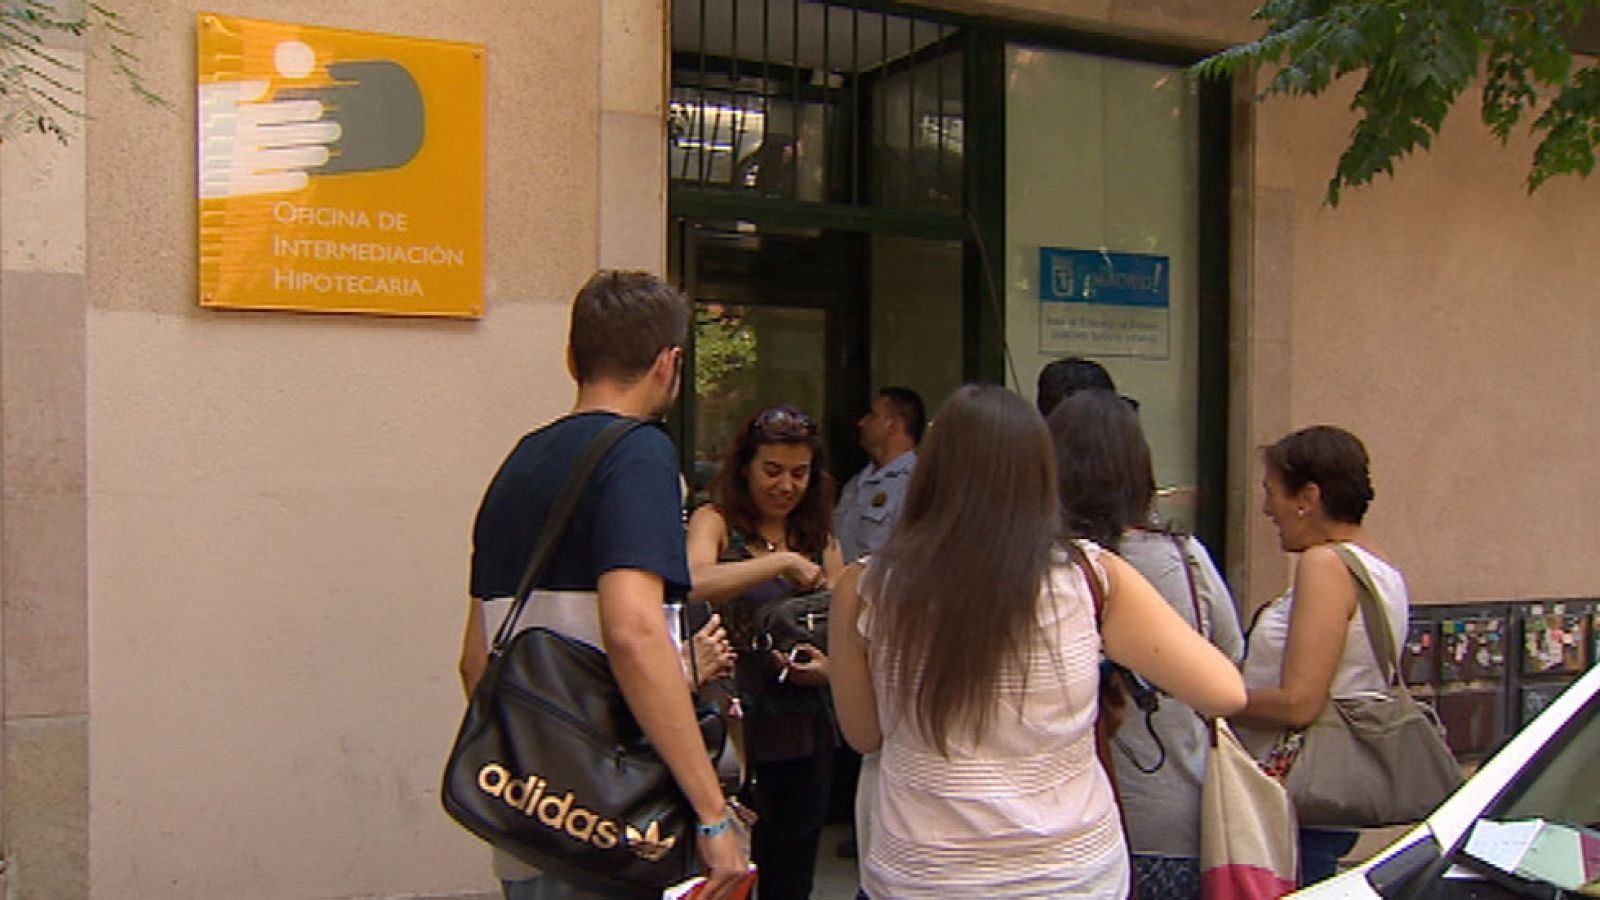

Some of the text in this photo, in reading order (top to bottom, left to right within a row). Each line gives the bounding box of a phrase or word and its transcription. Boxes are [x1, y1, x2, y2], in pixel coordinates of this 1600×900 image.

[273, 201, 408, 231] OFICINA DE
[273, 234, 464, 265] INTERMEDIACIÓN
[273, 268, 425, 297] HIPOTECARIA
[477, 763, 619, 849] adidas
